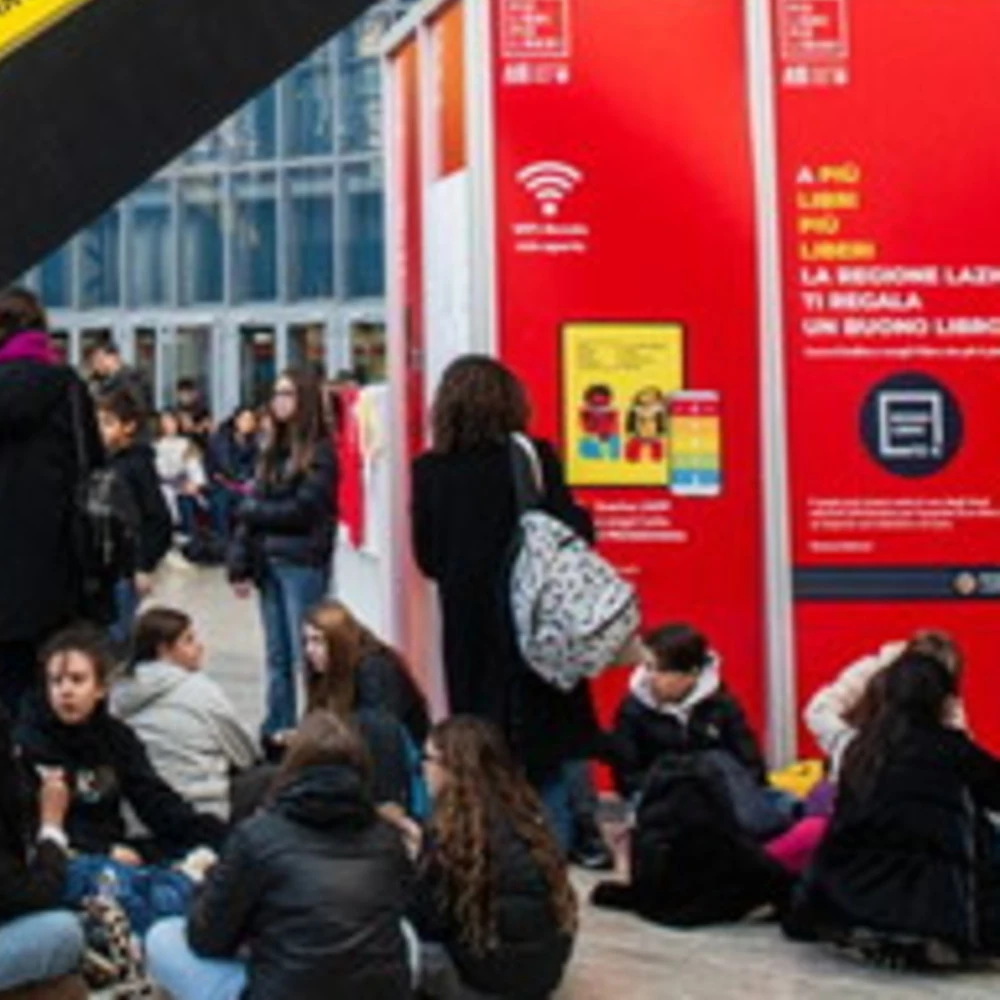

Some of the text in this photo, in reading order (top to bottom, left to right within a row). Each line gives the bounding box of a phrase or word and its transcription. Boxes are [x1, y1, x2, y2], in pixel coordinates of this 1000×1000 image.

[796, 165, 814, 184] A
[800, 266, 831, 286] LA
[836, 265, 940, 286] REGIONE
[801, 291, 924, 312] TI REGALA
